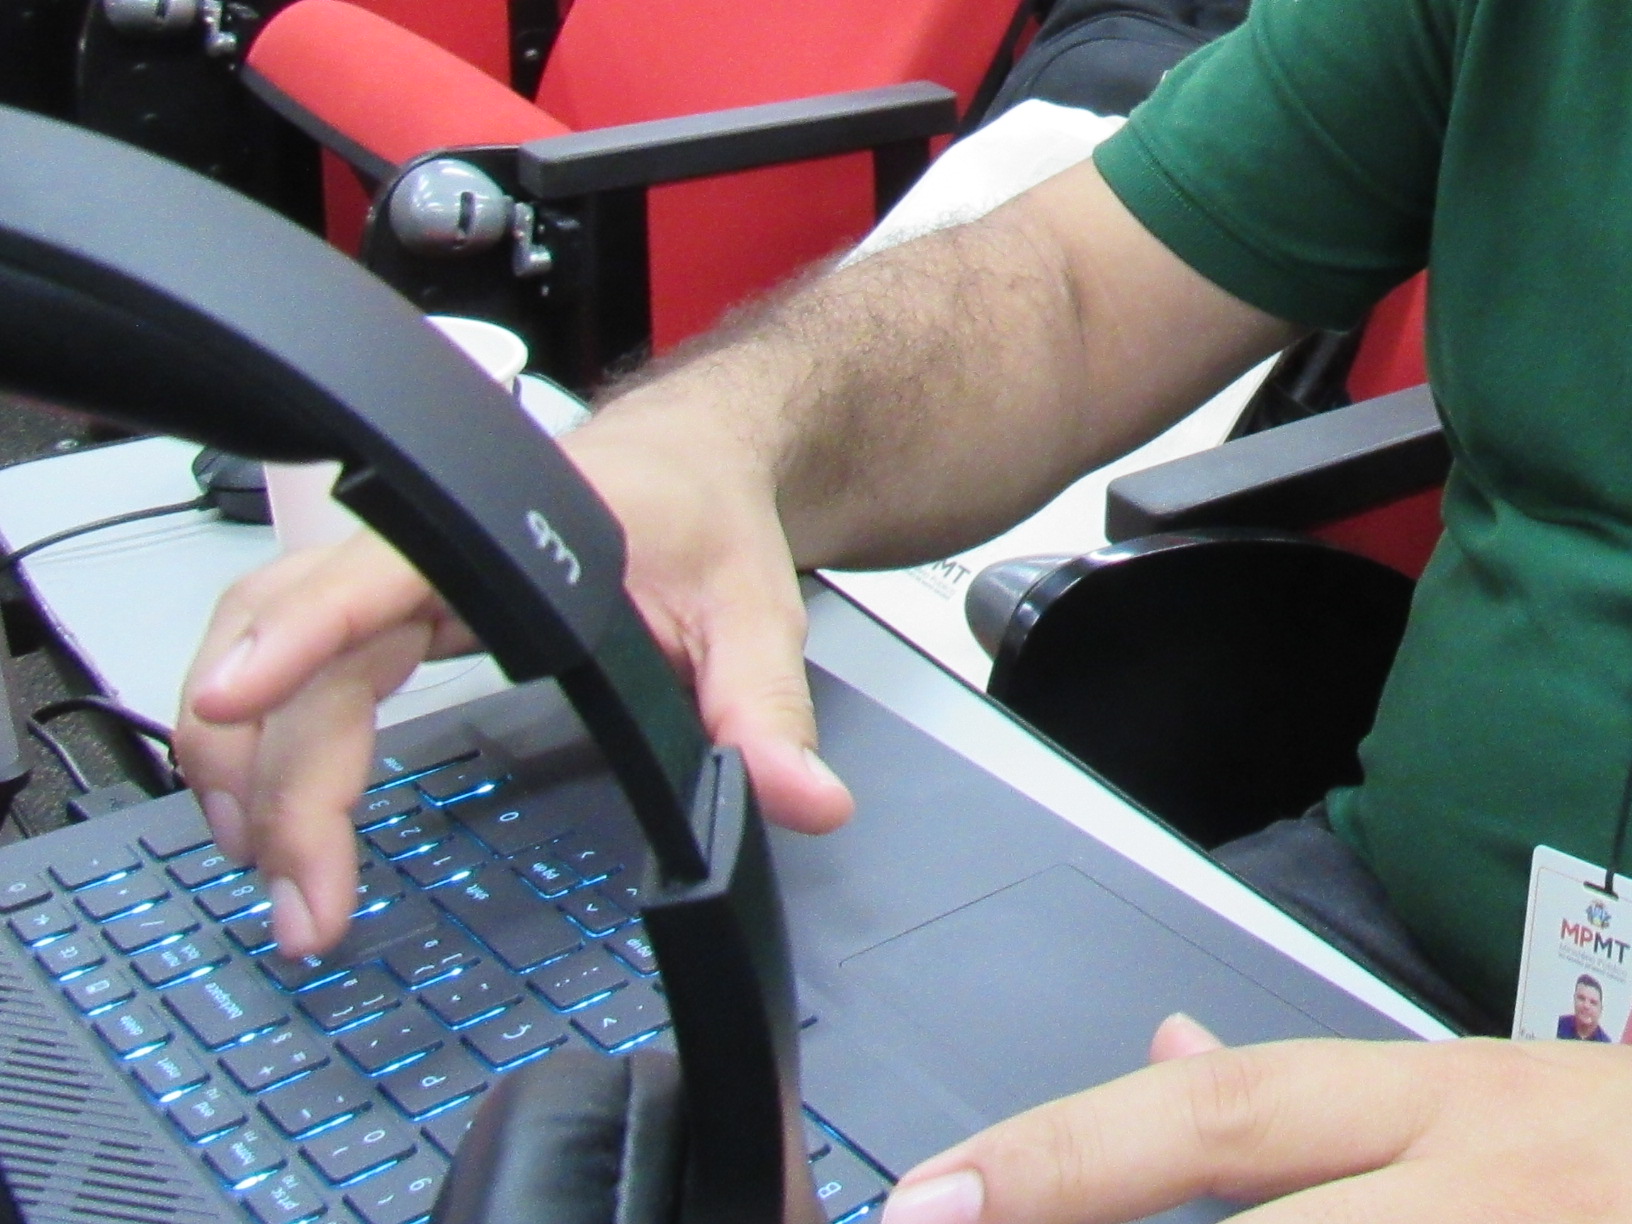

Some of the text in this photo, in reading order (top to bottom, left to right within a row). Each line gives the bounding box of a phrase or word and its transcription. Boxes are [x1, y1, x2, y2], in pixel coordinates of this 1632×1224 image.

[1560, 917, 1631, 964] MPMT
[421, 1075, 447, 1088] P
[817, 1181, 842, 1199] B
